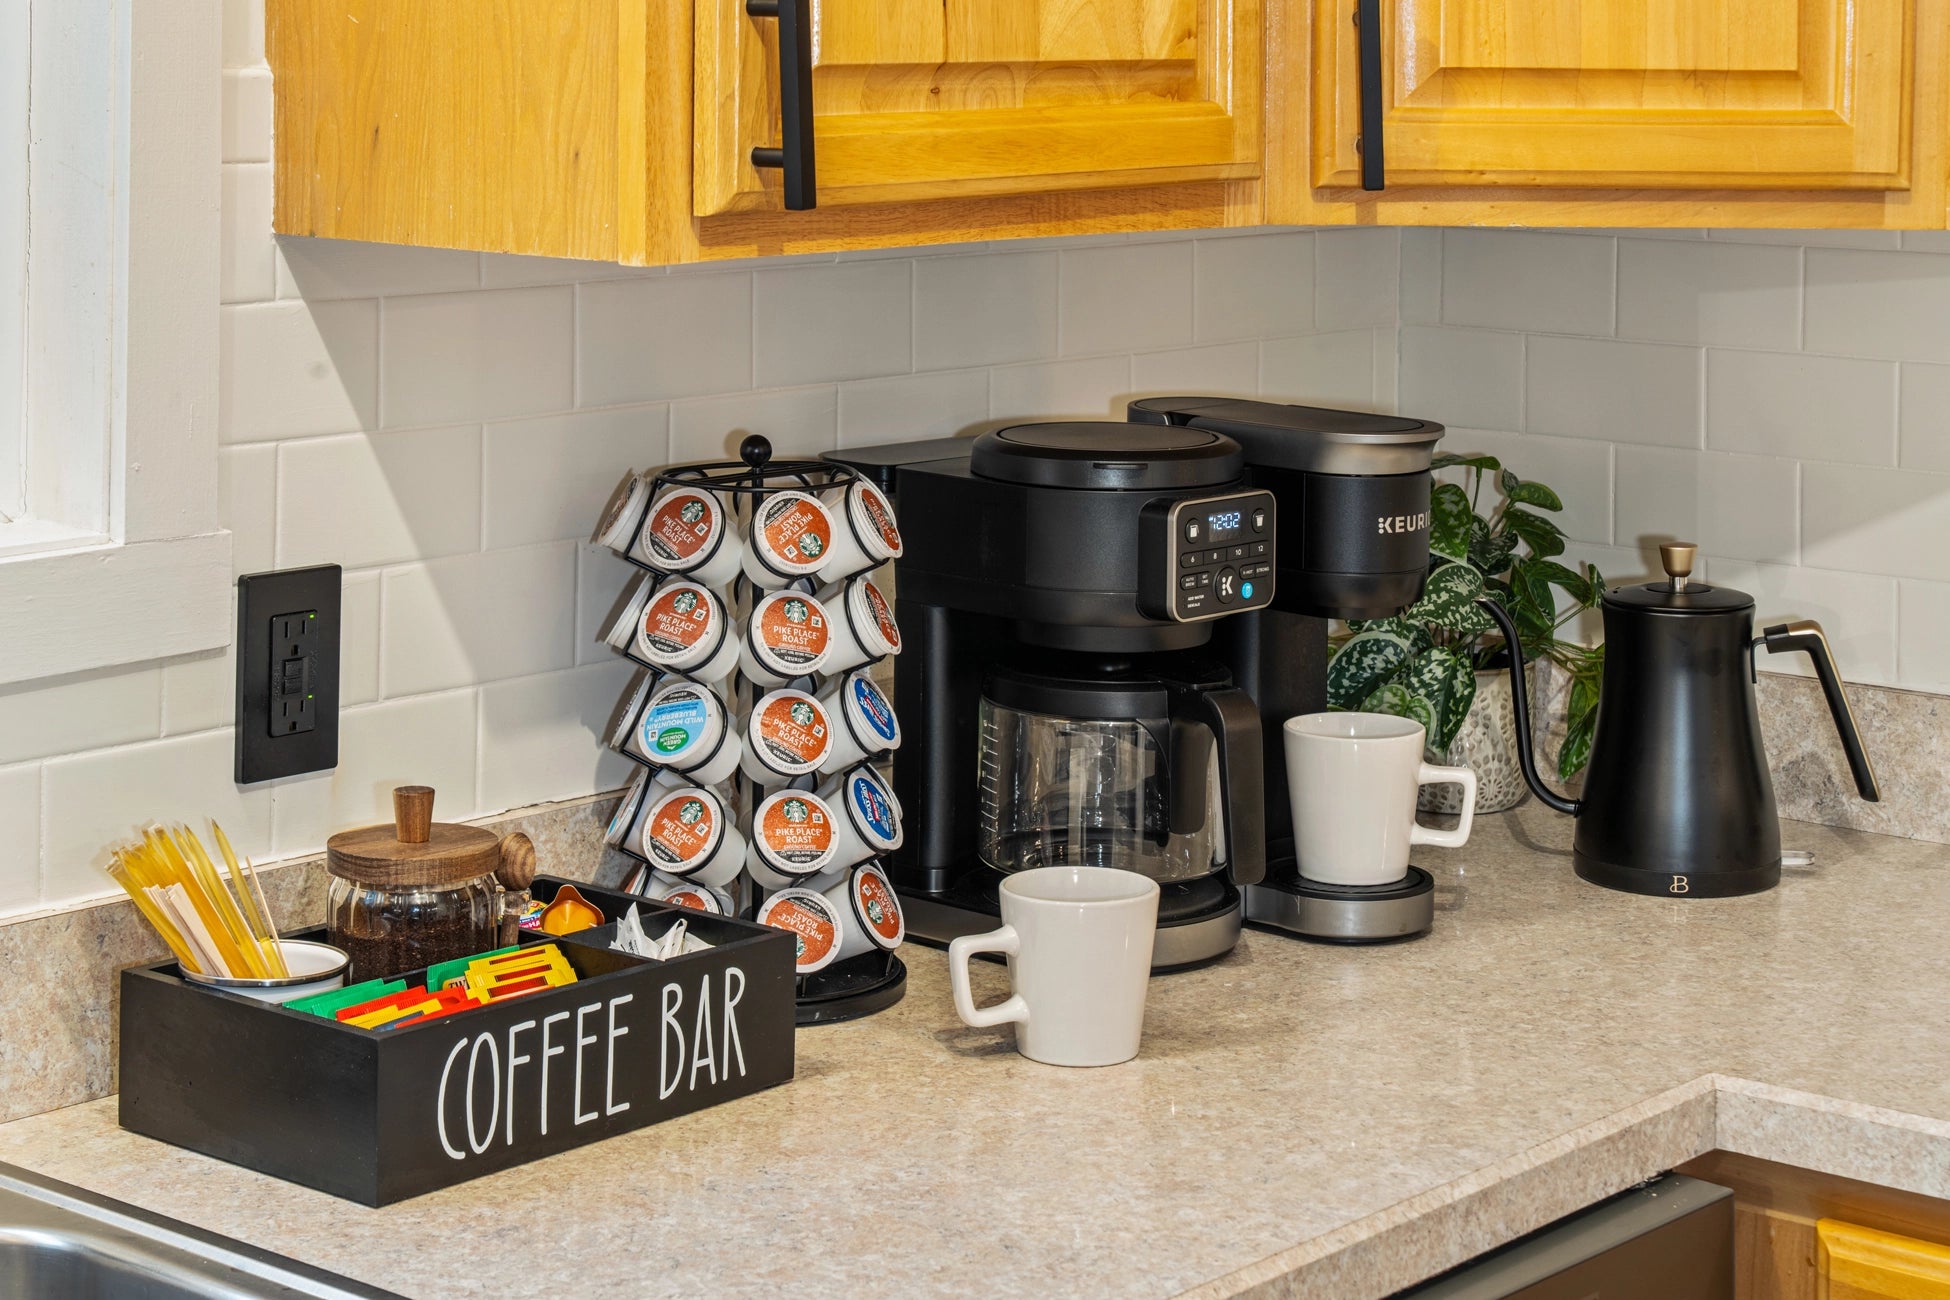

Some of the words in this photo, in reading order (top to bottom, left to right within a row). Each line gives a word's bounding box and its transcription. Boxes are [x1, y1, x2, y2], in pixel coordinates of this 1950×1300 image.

[662, 515, 676, 529] PIKE
[780, 512, 802, 531] ROAST
[798, 512, 813, 527] PIKE
[662, 526, 682, 544] ROAST
[1213, 552, 1218, 560] 8
[1235, 548, 1242, 556] 10
[656, 613, 672, 624] PIKE
[660, 623, 683, 635] ROAST
[773, 626, 792, 635] PIKE
[782, 634, 808, 645] ROAST
[658, 711, 697, 721] BLUEBERRY
[646, 720, 683, 731] MOUNTAIN
[773, 718, 791, 732] PIKE
[778, 730, 803, 748] ROAST
[661, 818, 676, 831] PIKE
[662, 829, 684, 846] ROAST
[776, 828, 794, 836] PIKE
[792, 911, 818, 929] ROAST
[805, 927, 824, 941] PIKE
[437, 994, 633, 1160] COFFEE
[659, 967, 746, 1101] BAR
